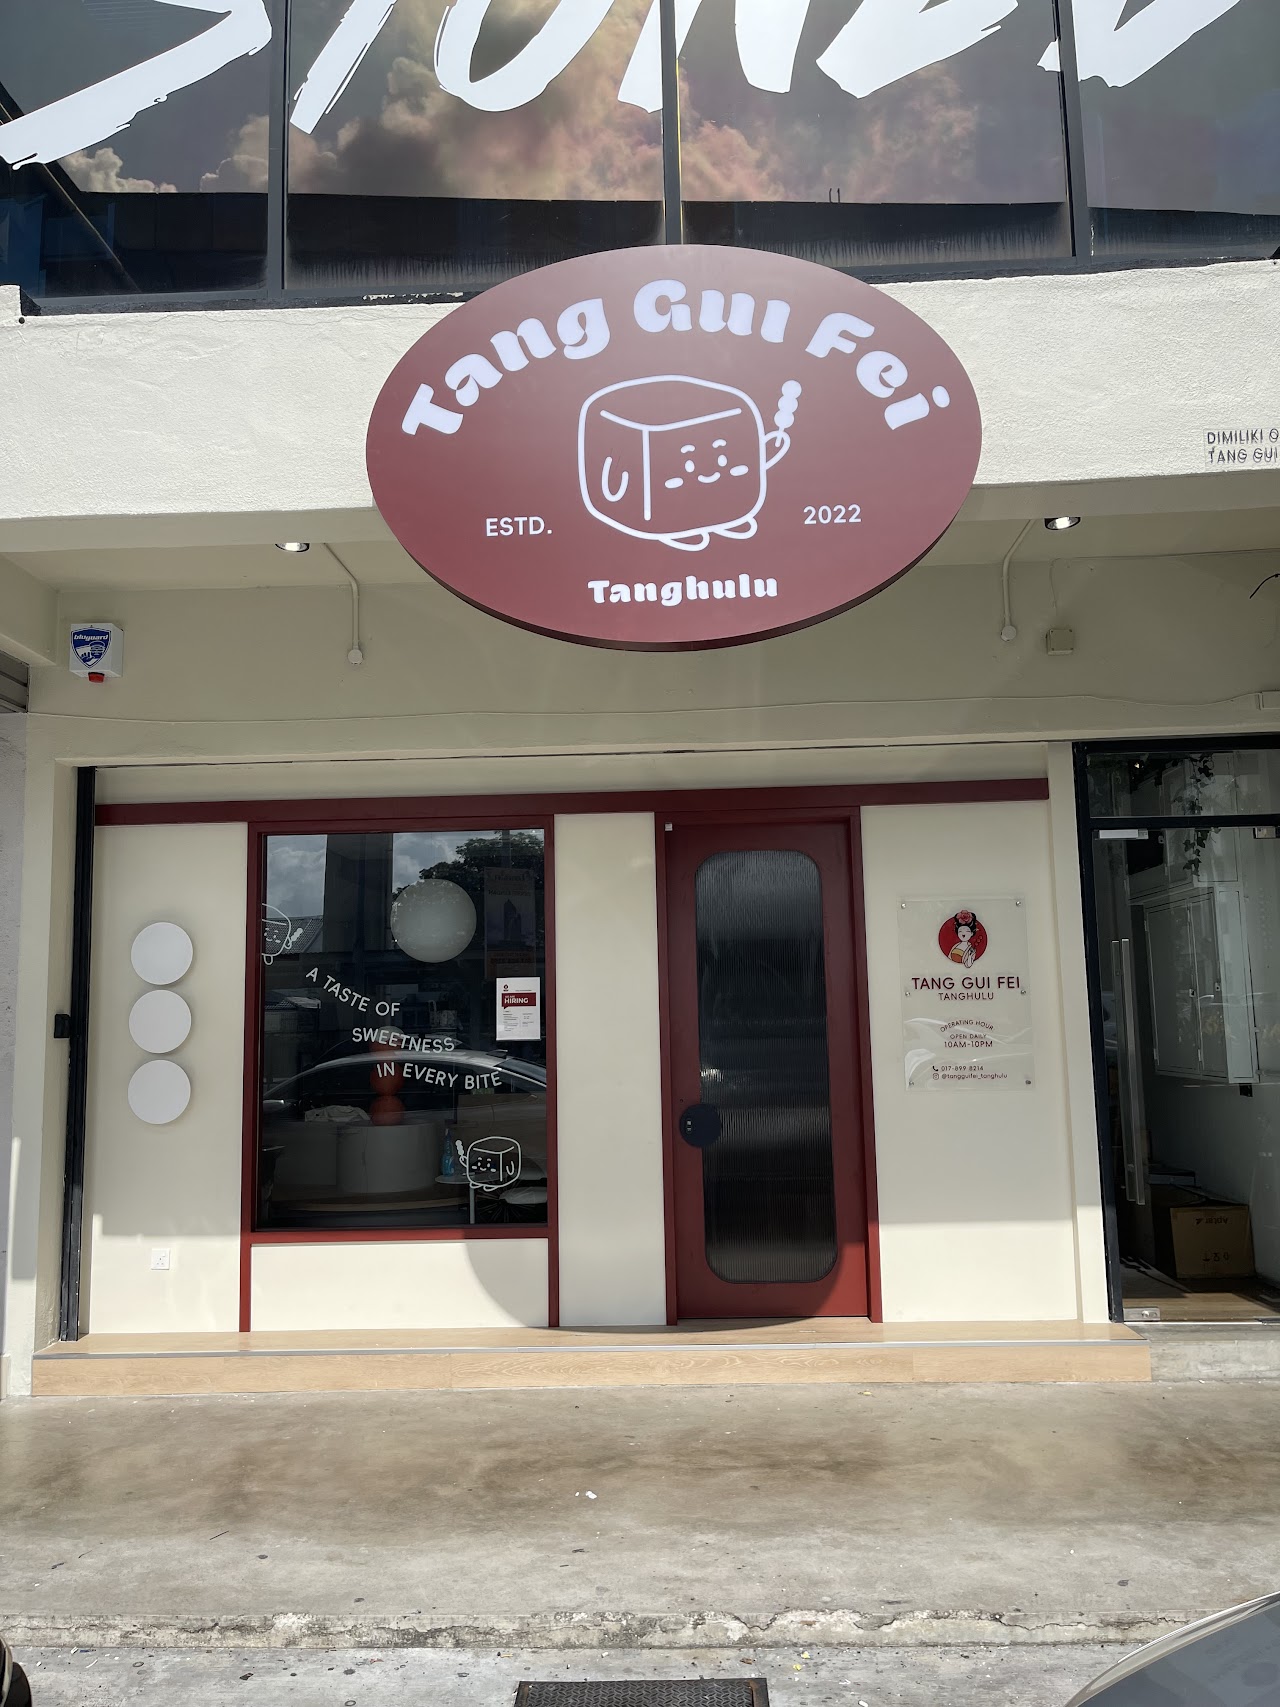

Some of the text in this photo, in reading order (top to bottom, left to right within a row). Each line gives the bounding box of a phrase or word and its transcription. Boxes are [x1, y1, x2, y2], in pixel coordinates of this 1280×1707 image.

[401, 279, 950, 436] Tang Gui Fei
[1207, 428, 1263, 444] DIMILIKI
[1208, 446, 1278, 463] TANG GUI
[485, 504, 862, 537] ESTD. 2022
[587, 573, 778, 607] Tanghulu
[306, 967, 400, 1017] A TASTE OF
[911, 976, 1020, 990] TANG GUI FEI
[938, 992, 994, 1001] TANGHULU
[940, 1019, 994, 1032] OPERATING HOUR
[352, 1027, 455, 1054] SWEETNESS
[944, 1040, 993, 1048] 10AM-10PM
[376, 1062, 502, 1090] IN EVERY BITE
